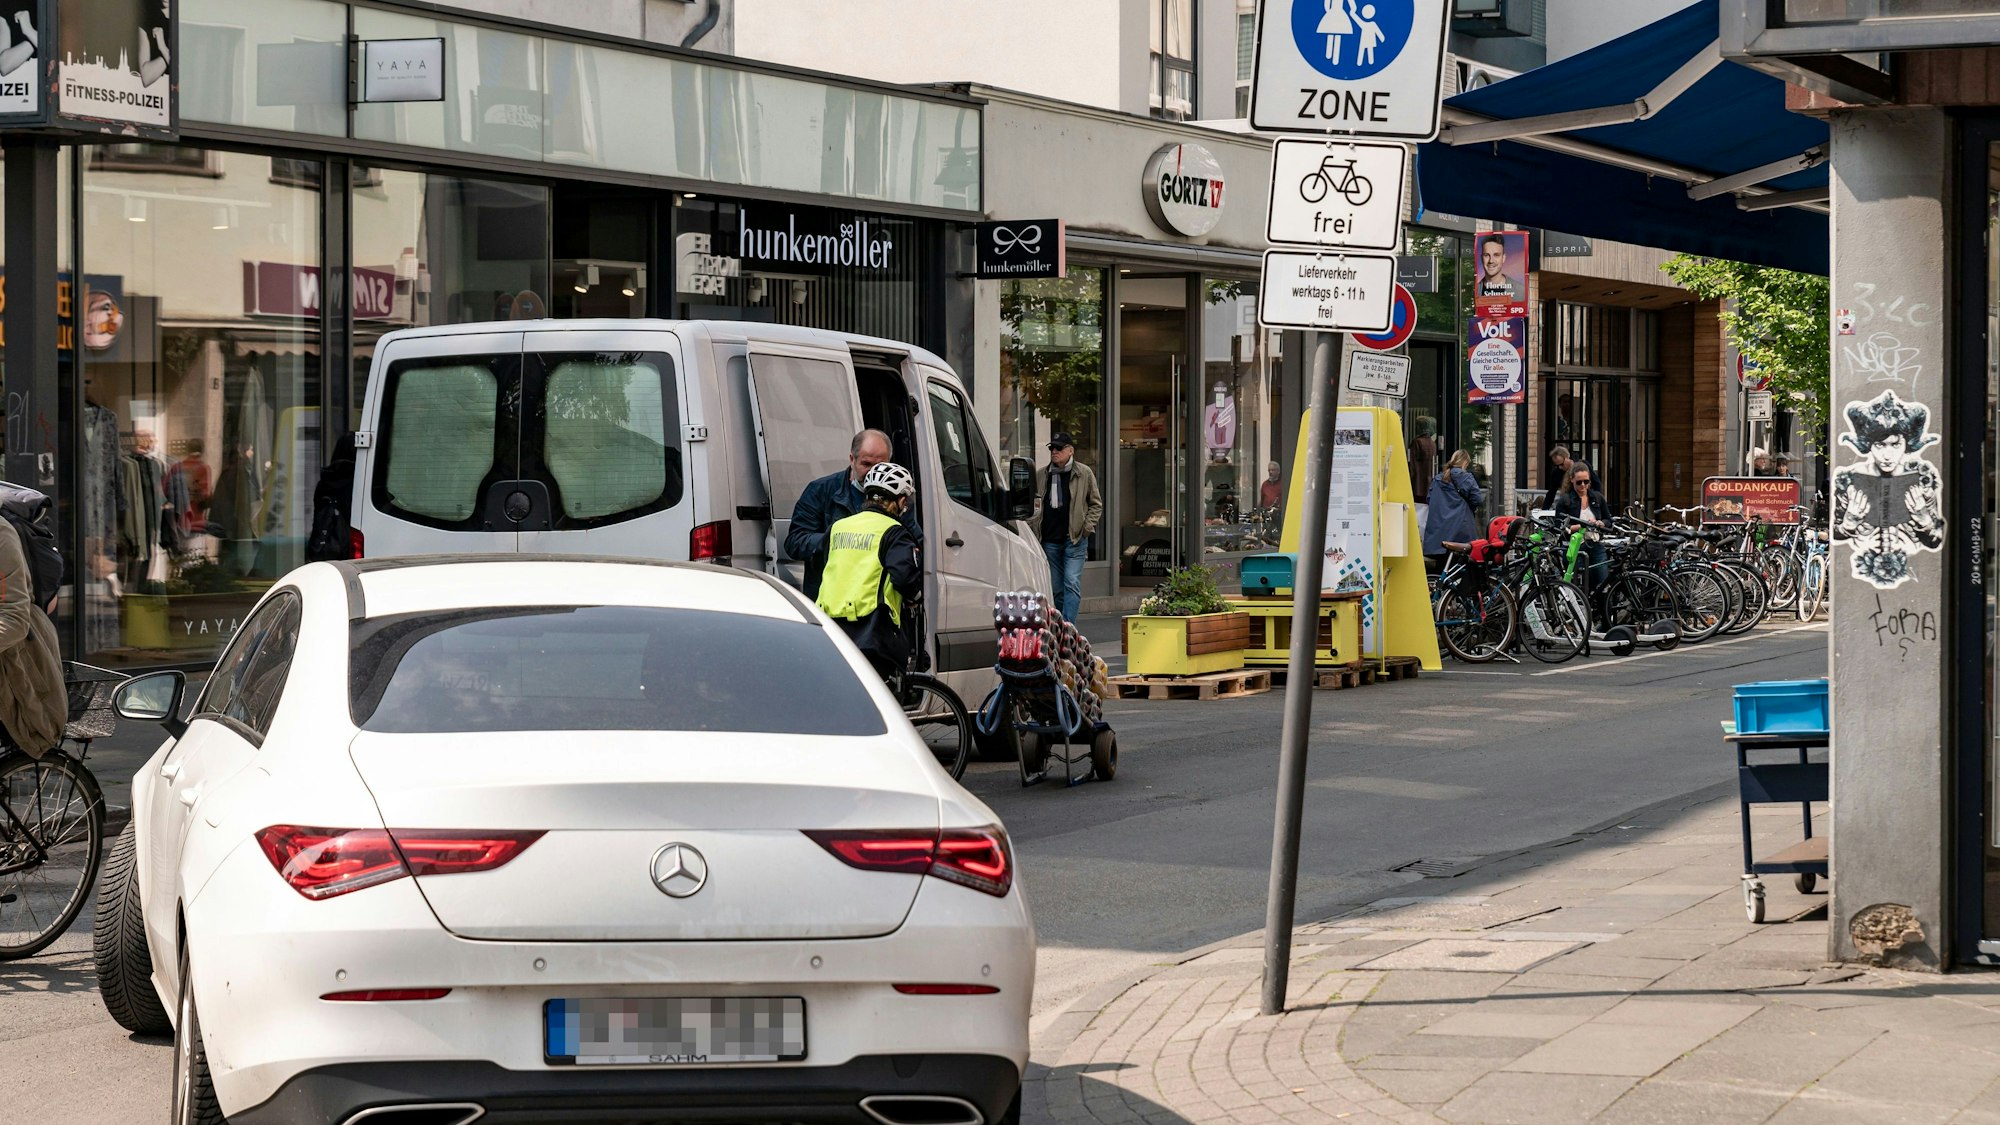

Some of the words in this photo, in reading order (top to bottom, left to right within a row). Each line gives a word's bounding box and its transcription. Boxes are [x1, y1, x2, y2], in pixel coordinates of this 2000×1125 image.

[66, 83, 164, 110] FITNESS-POLIZEI
[1298, 88, 1391, 122] ZONE
[1314, 212, 1353, 234] frei
[1548, 245, 1588, 253] ESPRIT
[1298, 264, 1357, 281] Lieferverkehr
[1292, 285, 1332, 302] werktags
[1333, 286, 1340, 298] 6
[1347, 287, 1357, 299] 11
[1359, 287, 1365, 300] h
[1317, 305, 1333, 319] frei
[1477, 321, 1512, 338] Volt
[1709, 482, 1794, 492] GOLDANKAUF
[184, 617, 239, 636] YAYA
